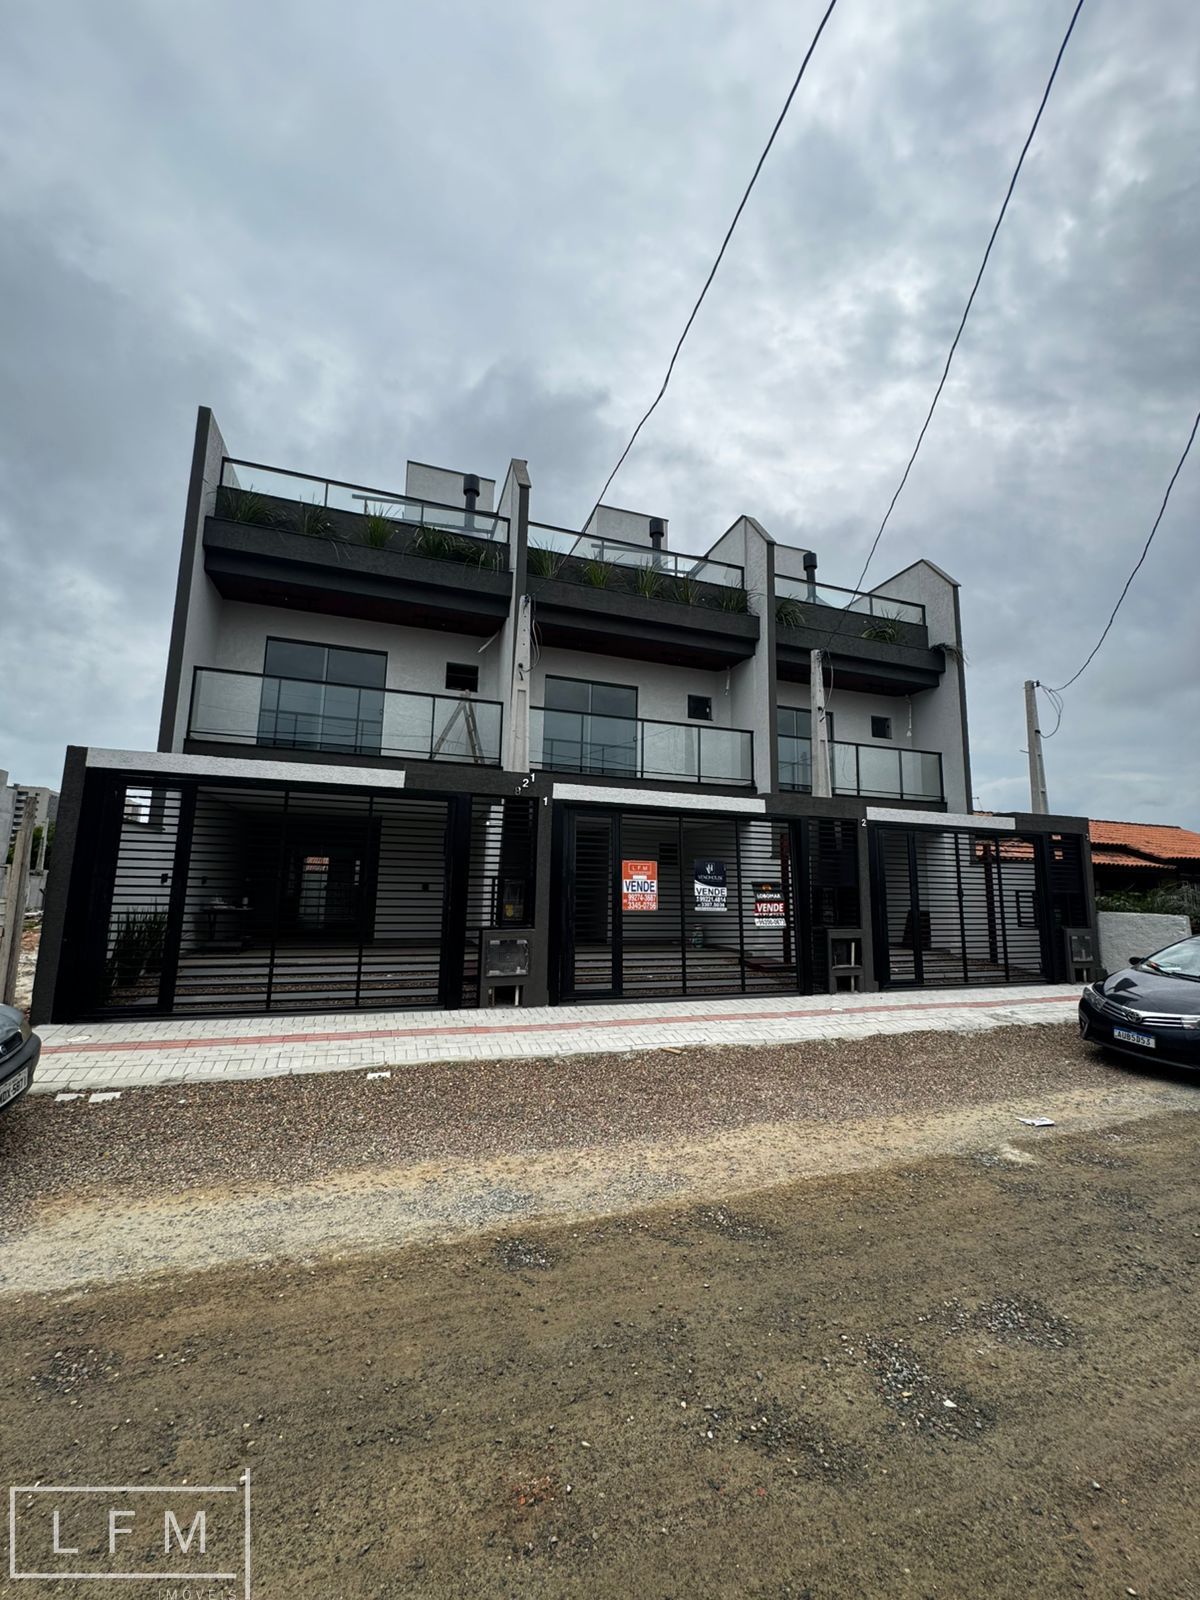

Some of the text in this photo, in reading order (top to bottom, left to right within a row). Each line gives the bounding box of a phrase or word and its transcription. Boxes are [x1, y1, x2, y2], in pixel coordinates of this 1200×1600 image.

[543, 796, 548, 806] 1
[861, 818, 867, 827] 2
[625, 880, 656, 892] VENDE
[695, 887, 726, 896] VENDE
[756, 902, 784, 912] VENDE
